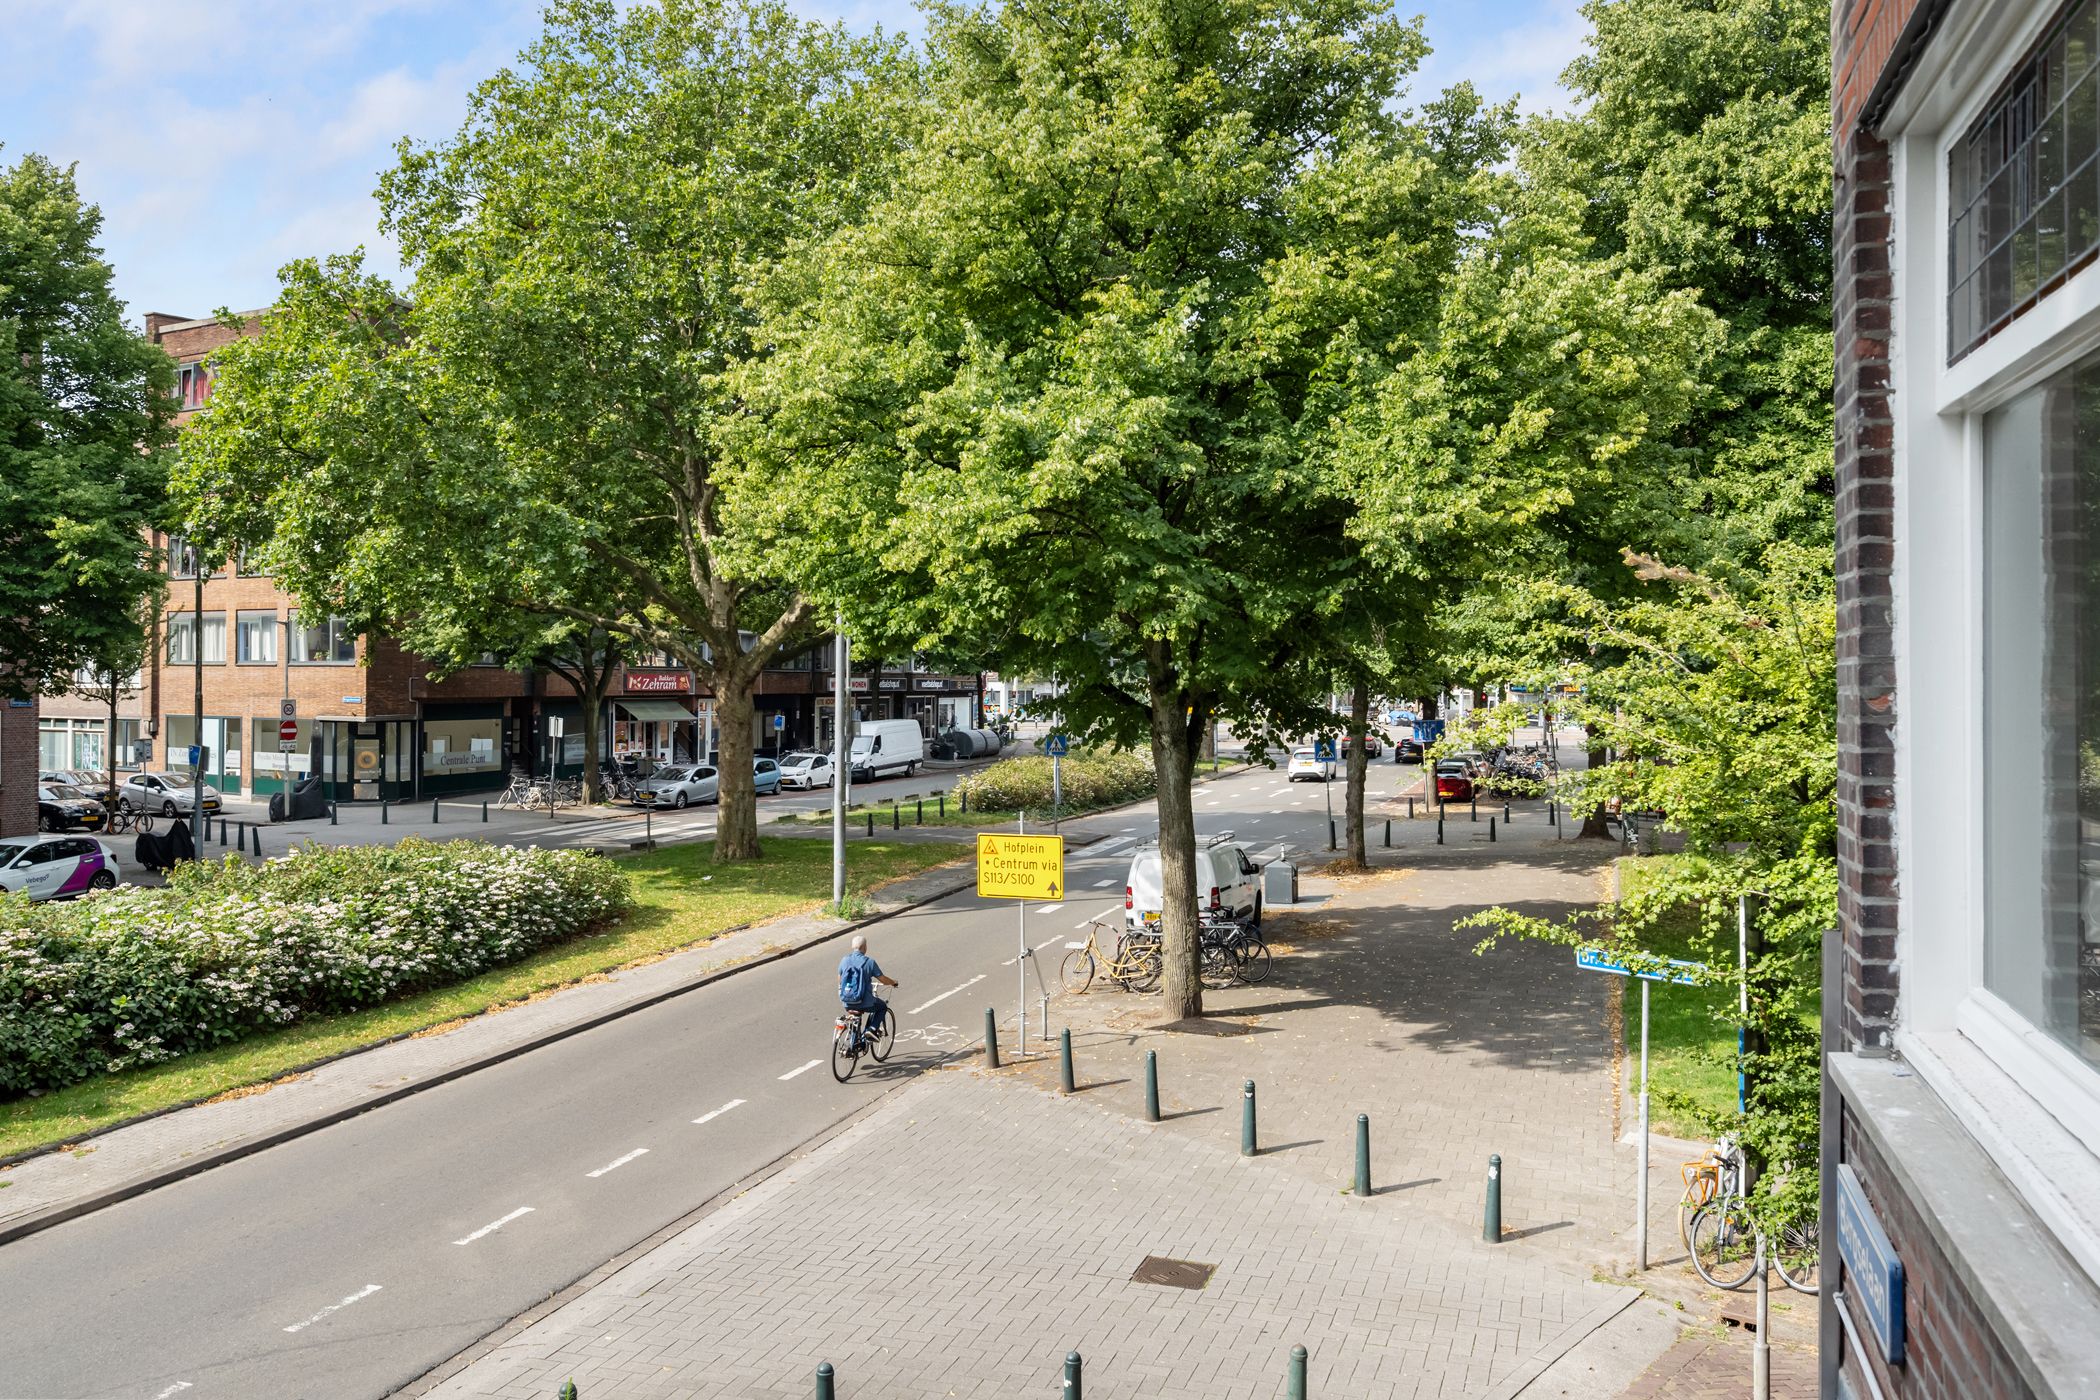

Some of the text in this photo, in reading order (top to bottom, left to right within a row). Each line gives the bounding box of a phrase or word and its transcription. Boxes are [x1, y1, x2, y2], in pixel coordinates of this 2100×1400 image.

[642, 678, 677, 690] Zehram
[441, 754, 486, 766] Centrale Punt
[1004, 842, 1044, 854] Hofplein
[993, 857, 1057, 871] Centrum via
[25, 875, 47, 884] Vebego
[983, 872, 1035, 885] S113/S100
[1840, 1194, 1886, 1323] Bergselaan
